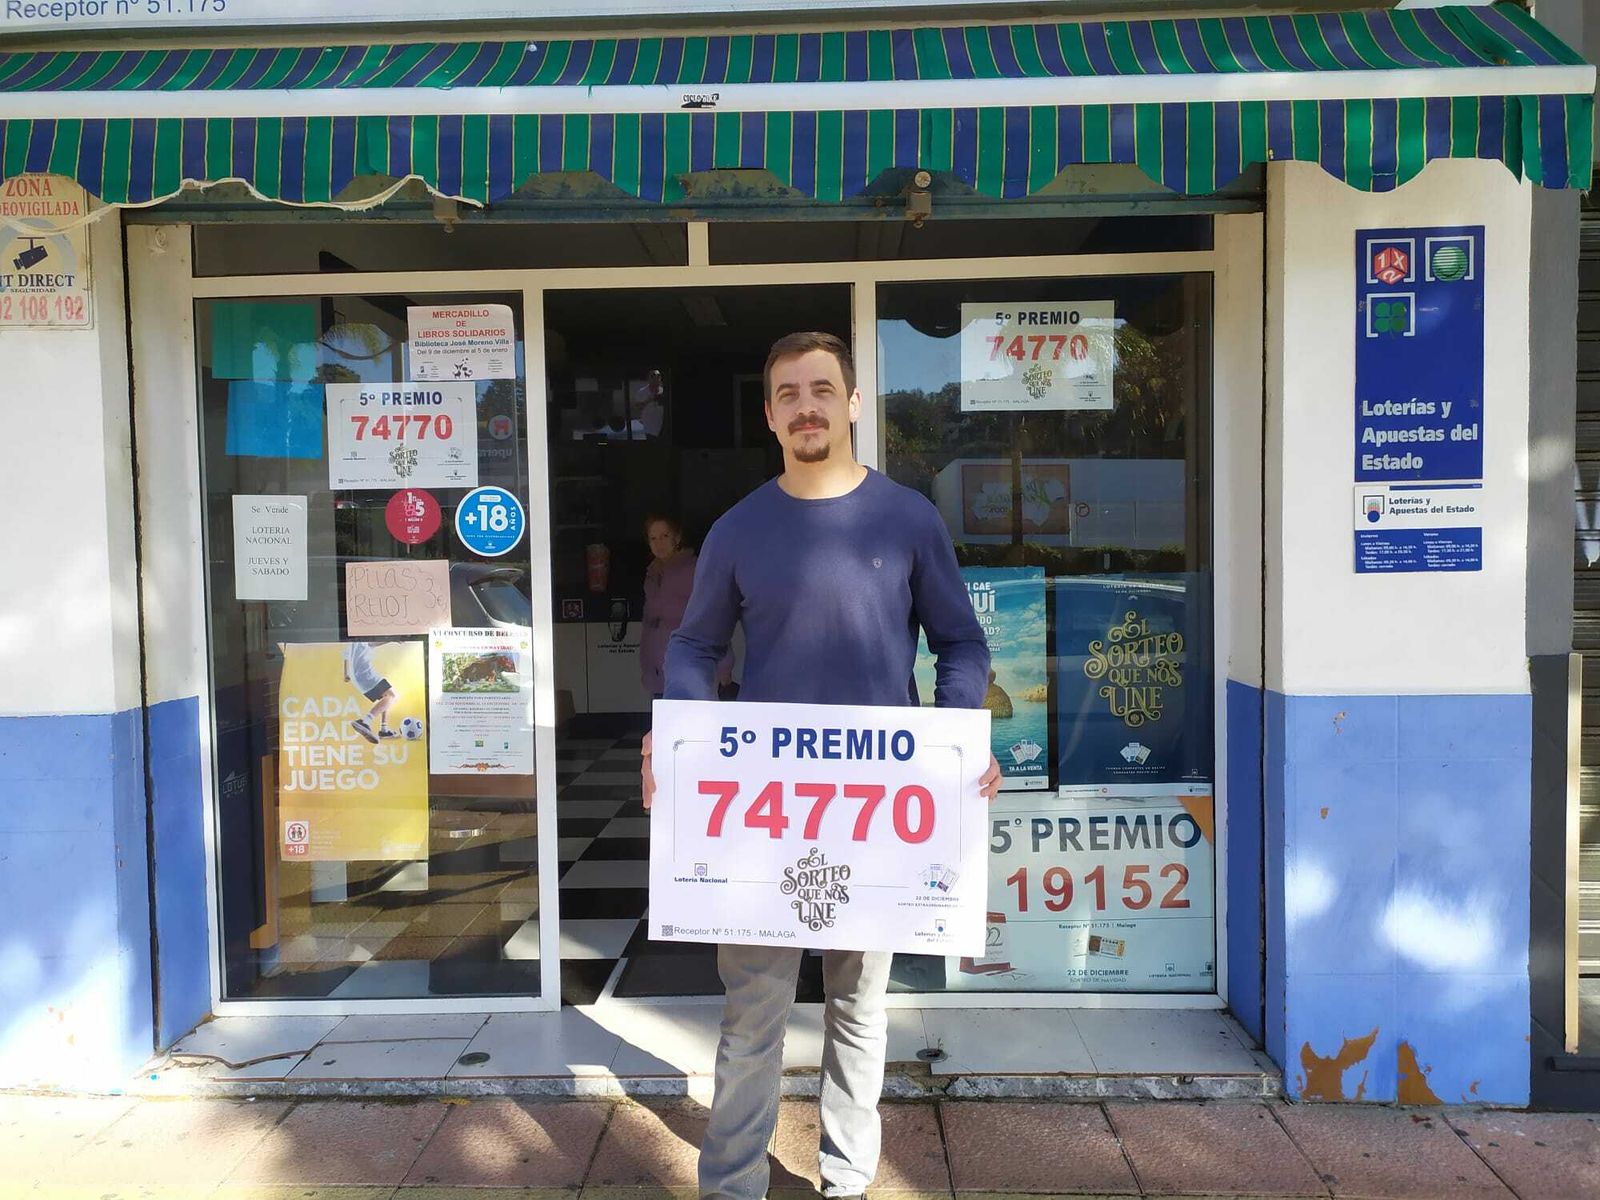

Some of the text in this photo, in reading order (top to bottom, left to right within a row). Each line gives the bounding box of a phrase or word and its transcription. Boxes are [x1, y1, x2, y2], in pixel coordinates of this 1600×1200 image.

[6, 0, 108, 21] Receptor
[5, 178, 53, 197] ZONA
[0, 201, 79, 216] EOVIGILADA
[18, 274, 75, 287] DIRECT
[19, 295, 48, 320] 108
[55, 295, 84, 320] 192
[432, 310, 489, 318] MERCADILLO
[996, 311, 1080, 326] 5º PREMIO
[418, 329, 505, 338] LIBROS SOLIDARIOS
[986, 335, 1088, 361] 74770
[360, 392, 442, 406] 5º PREMIO
[1362, 398, 1451, 418] Loterías y
[351, 414, 453, 440] 74770
[1362, 424, 1477, 447] Apuestas del
[1362, 453, 1423, 470] Estado
[465, 505, 508, 531] +18
[1390, 507, 1427, 515] Apuestas
[973, 582, 991, 590] CAE
[1108, 611, 1151, 642] EL
[1084, 632, 1183, 679] SORTEO
[1108, 659, 1182, 687] QUE NOS
[282, 697, 361, 718] CADA
[1100, 686, 1163, 727] UNE
[283, 721, 359, 743] EDAD
[720, 726, 916, 761] 5º PREMIO
[283, 744, 409, 767] TIENE SU
[283, 768, 380, 791] JUEGO
[698, 781, 936, 844] 74770
[1031, 813, 1201, 852] PREMIO
[288, 845, 305, 854] +18
[797, 847, 828, 869] EL
[780, 865, 850, 895] SORTEO
[1006, 863, 1191, 912] 19152
[798, 883, 849, 904] QUE NOS
[791, 900, 836, 931] UNE
[674, 927, 710, 936] Receptor
[725, 929, 751, 937] 51.175
[759, 930, 796, 938] MALAGA
